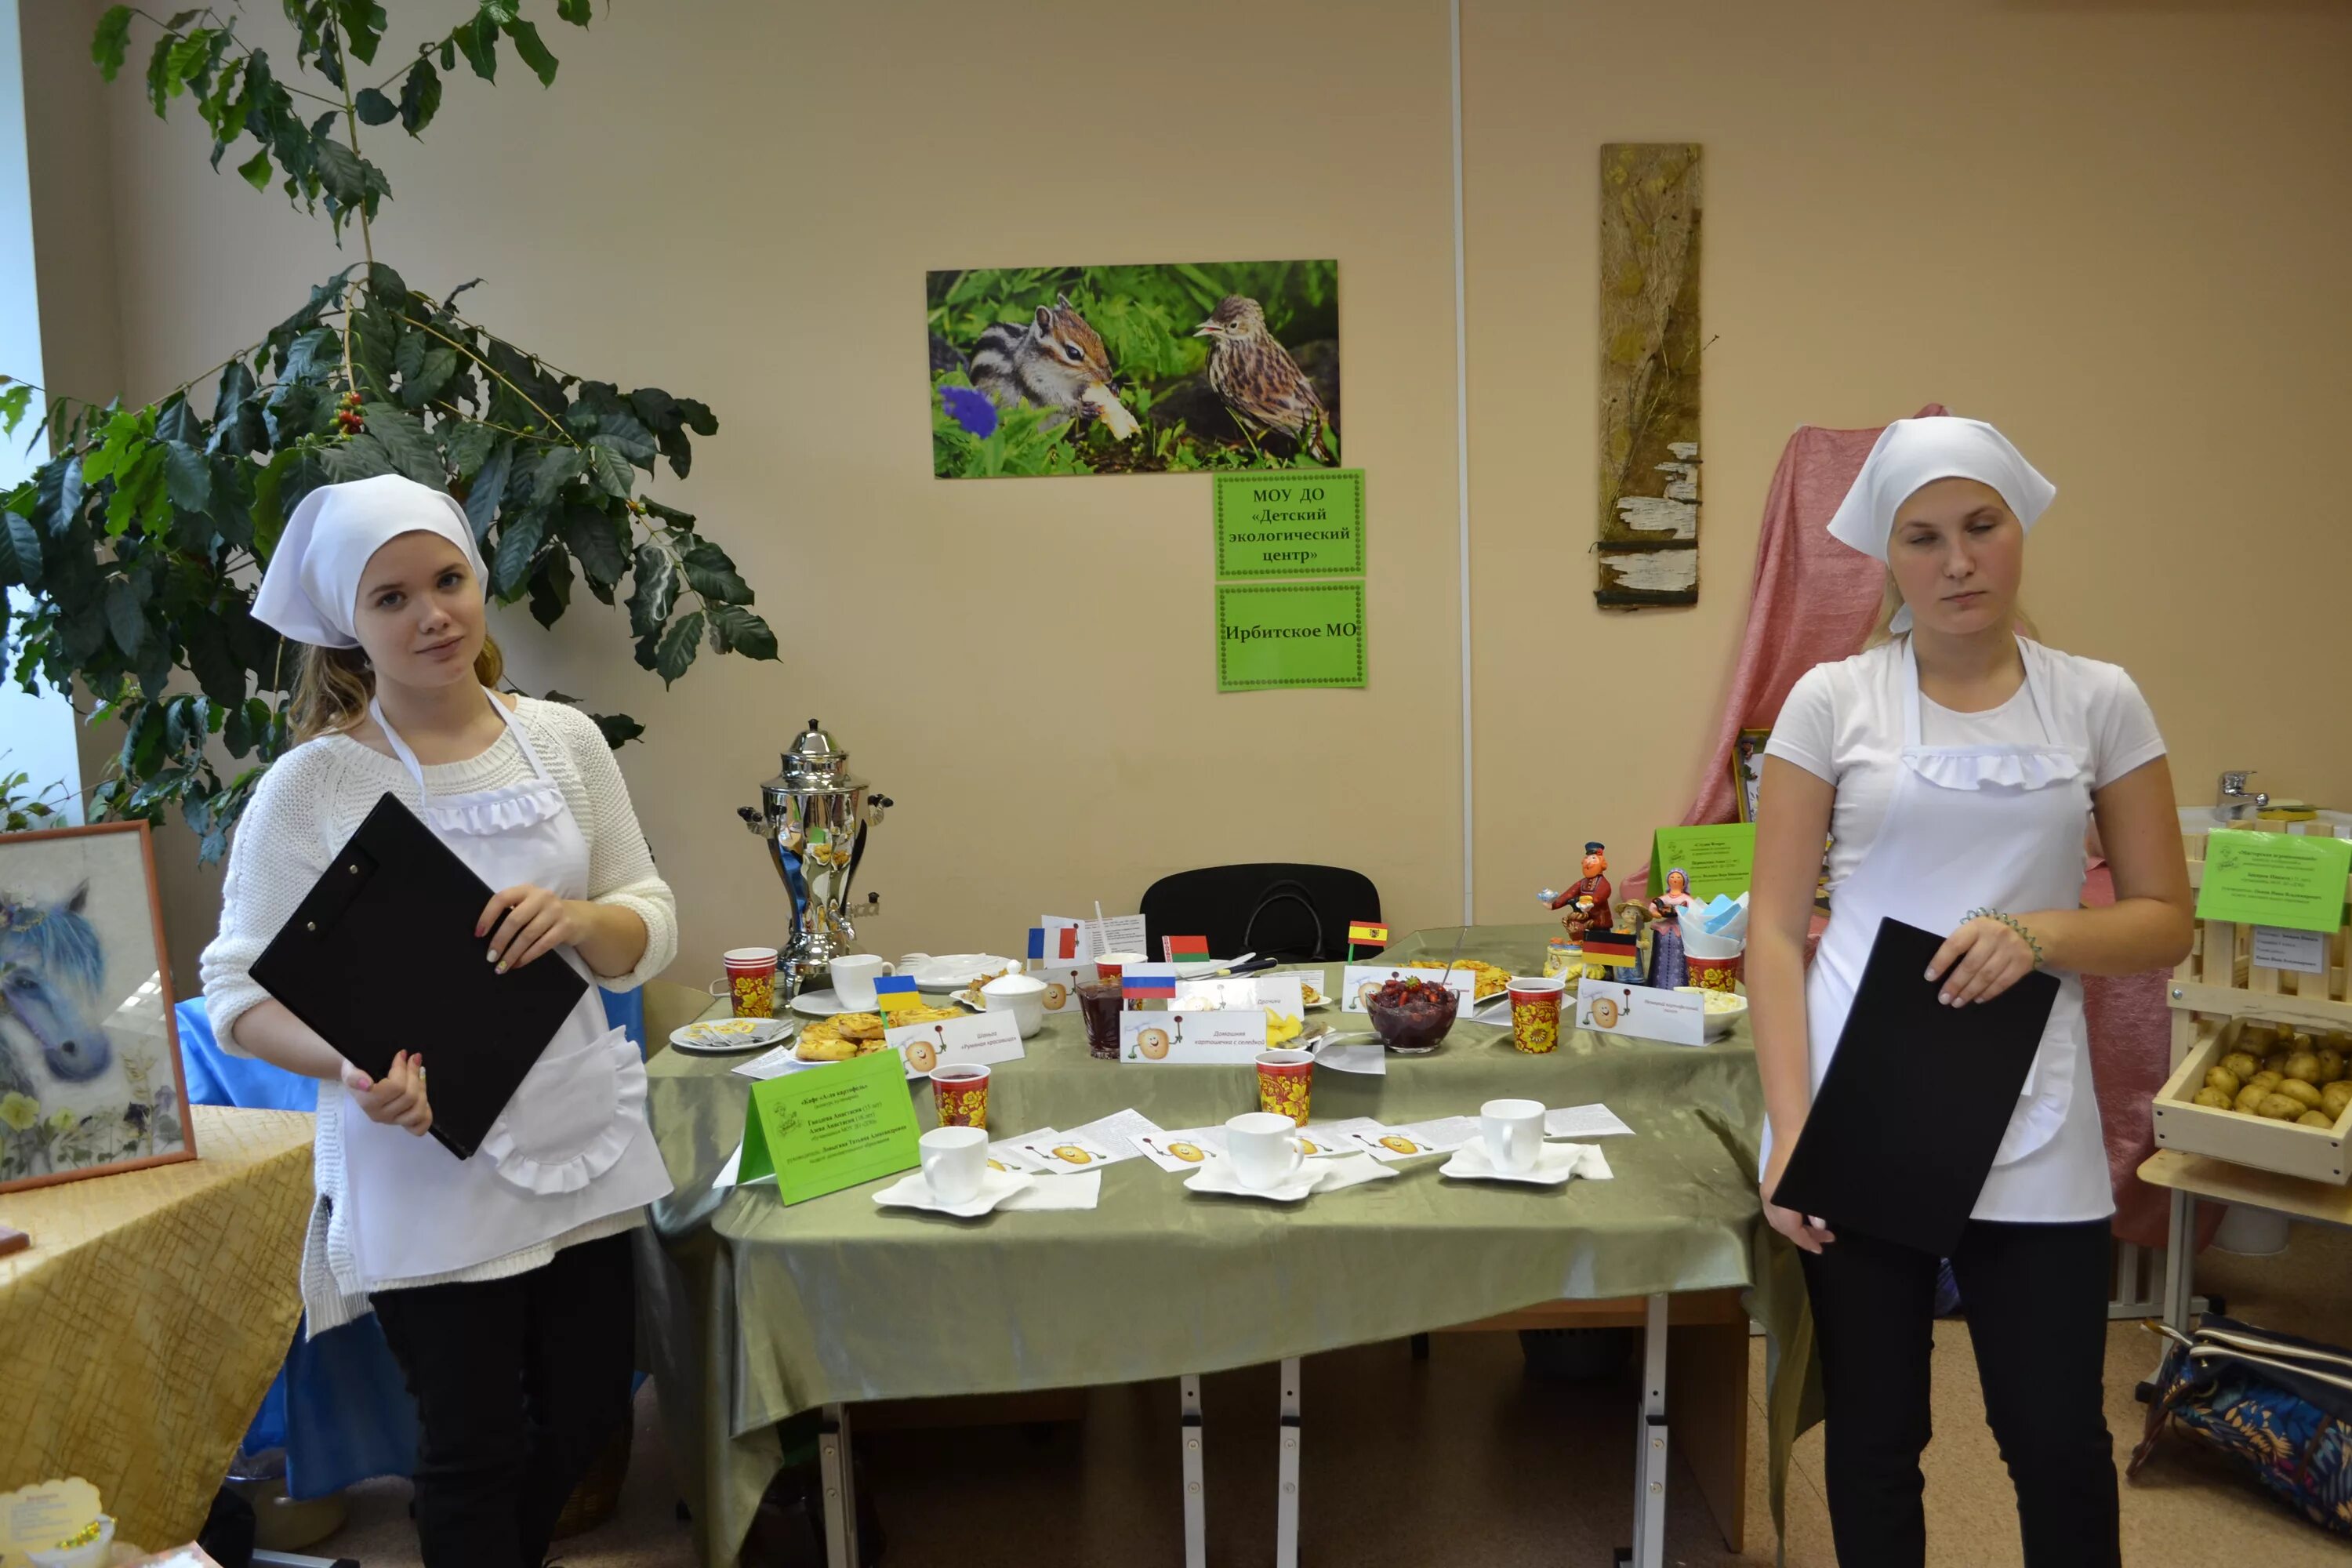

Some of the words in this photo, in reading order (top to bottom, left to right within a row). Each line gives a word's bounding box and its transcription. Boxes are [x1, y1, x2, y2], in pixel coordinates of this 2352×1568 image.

[1253, 488, 1292, 503] МОУ
[1299, 488, 1325, 504] ДО
[1251, 508, 1327, 525] «Детский
[1229, 527, 1351, 543] экологический
[1262, 549, 1318, 564] центр»
[1225, 624, 1322, 643] Ирбитское
[1327, 622, 1357, 637] МО
